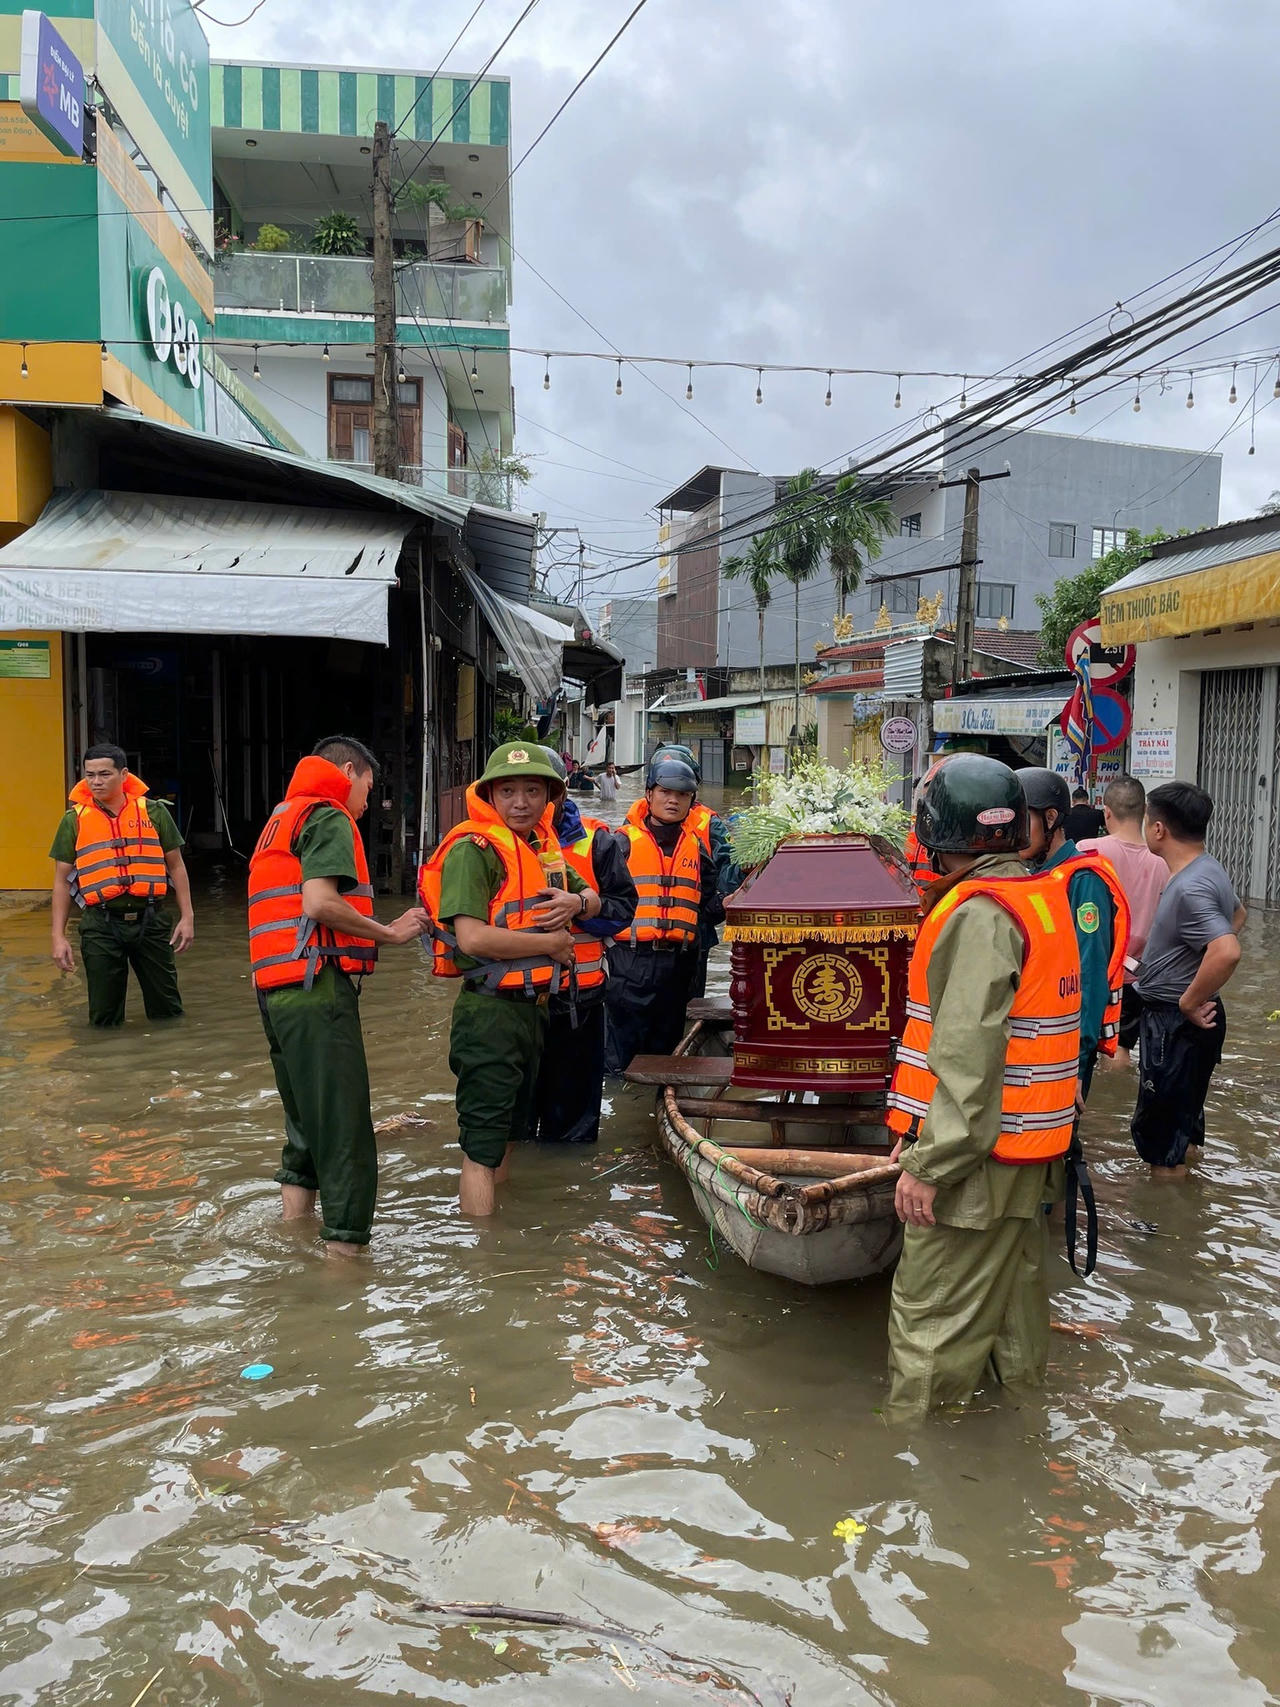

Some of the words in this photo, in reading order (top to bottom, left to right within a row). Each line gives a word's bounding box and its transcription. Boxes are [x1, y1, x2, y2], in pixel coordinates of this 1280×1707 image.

[60, 83, 79, 128] MB
[1127, 590, 1156, 620] THUỐC
[1160, 584, 1180, 614] BẮC
